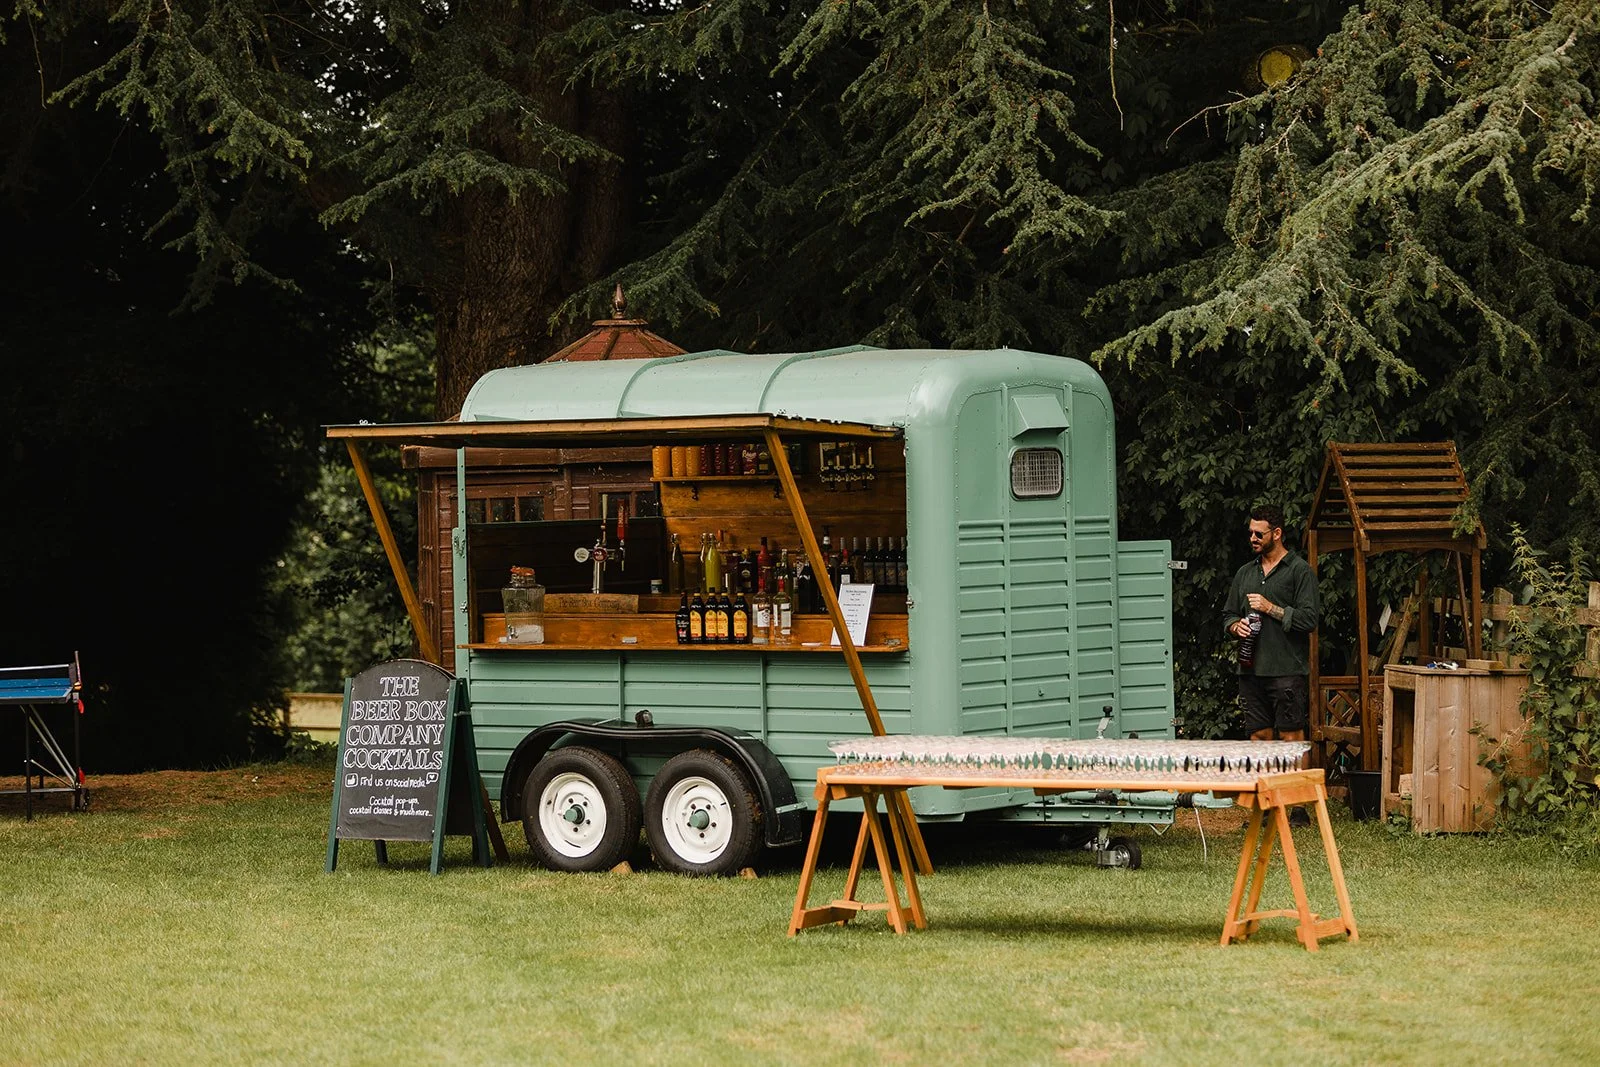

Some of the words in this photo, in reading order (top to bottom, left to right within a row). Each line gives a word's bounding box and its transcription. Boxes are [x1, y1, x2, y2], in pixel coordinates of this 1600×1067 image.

[380, 676, 420, 697] THE
[351, 699, 401, 721] BEER
[404, 700, 447, 722] BOX
[346, 723, 445, 746] COMPANY
[343, 747, 443, 771] COCKTAILS
[360, 774, 373, 787] Find
[374, 778, 384, 787] us
[385, 778, 393, 787] on
[369, 794, 394, 806] Cocktail
[348, 806, 372, 815] cocktail
[373, 807, 393, 815] classes
[393, 809, 399, 817] &
[399, 807, 416, 817] much
